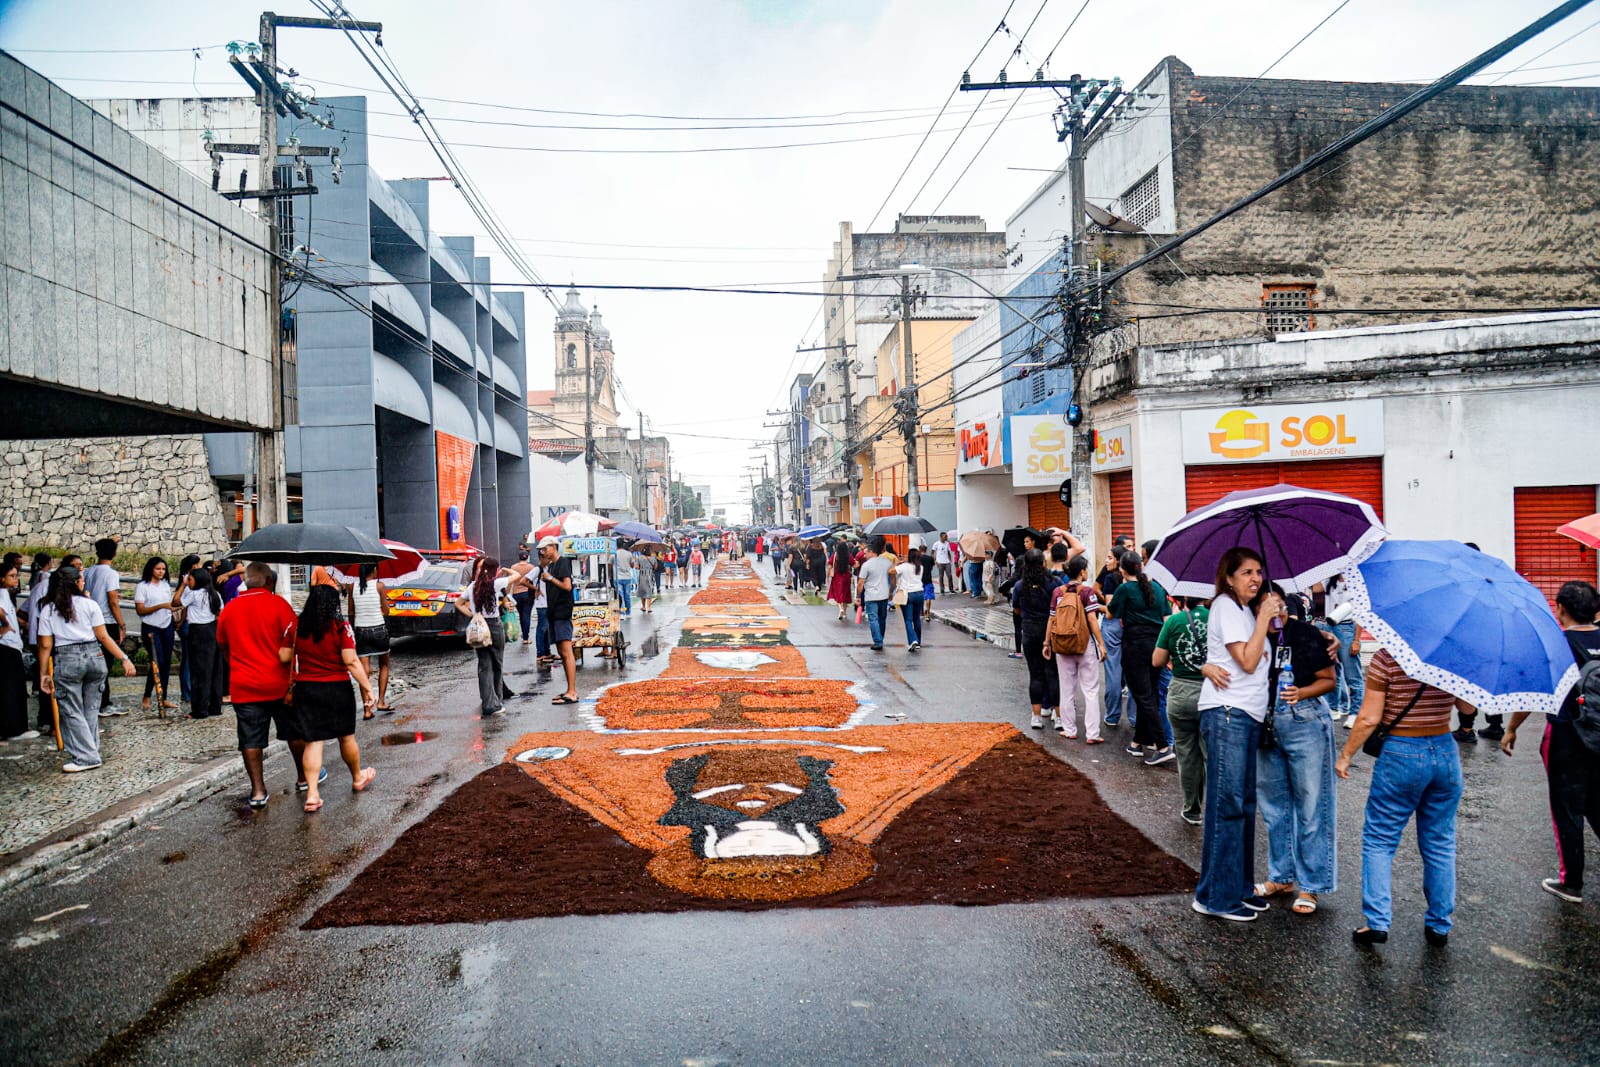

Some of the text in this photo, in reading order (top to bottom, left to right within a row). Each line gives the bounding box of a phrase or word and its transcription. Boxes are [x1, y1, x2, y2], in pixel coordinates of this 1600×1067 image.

[1280, 414, 1357, 448] SOL
[1108, 436, 1125, 458] SOL
[1290, 447, 1347, 457] EMBALAGENS
[1026, 453, 1071, 474] SOL
[576, 539, 606, 551] CHURROS
[572, 609, 606, 620] CHURROS
